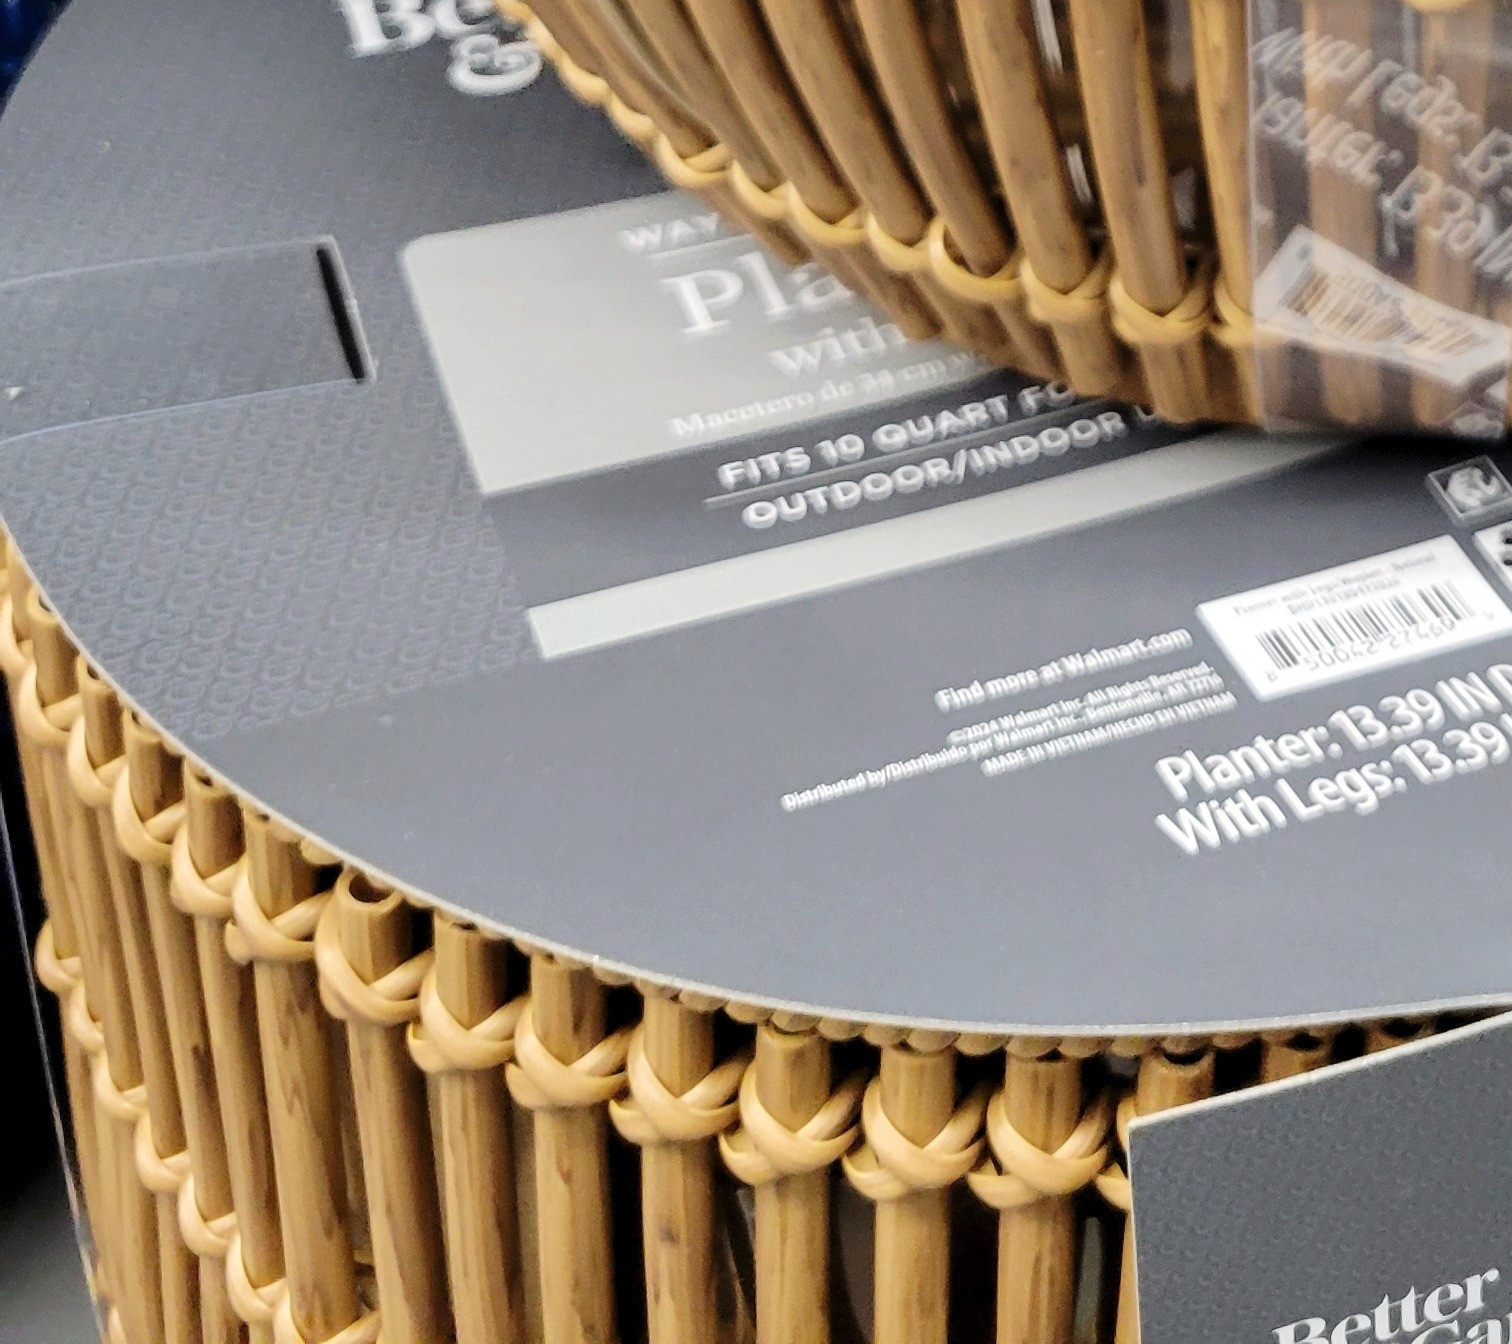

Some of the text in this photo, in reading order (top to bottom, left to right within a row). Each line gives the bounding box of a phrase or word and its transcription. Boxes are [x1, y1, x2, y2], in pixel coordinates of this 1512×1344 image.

[767, 315, 909, 382] with
[716, 445, 812, 492] FITS
[813, 433, 866, 468] 10
[871, 393, 1012, 454] QUART
[741, 408, 1129, 531] OUTDOOR/INDOOR
[934, 628, 1194, 713] Find more at Walmart.com
[980, 746, 1030, 777] MADE
[1154, 724, 1343, 803] Planter:
[1327, 687, 1446, 752] 13.39
[1435, 672, 1502, 723] IN
[779, 771, 867, 813] Distributed
[1153, 787, 1288, 857] With
[1274, 757, 1409, 822] Legs:
[1393, 720, 1511, 786] 13.39
